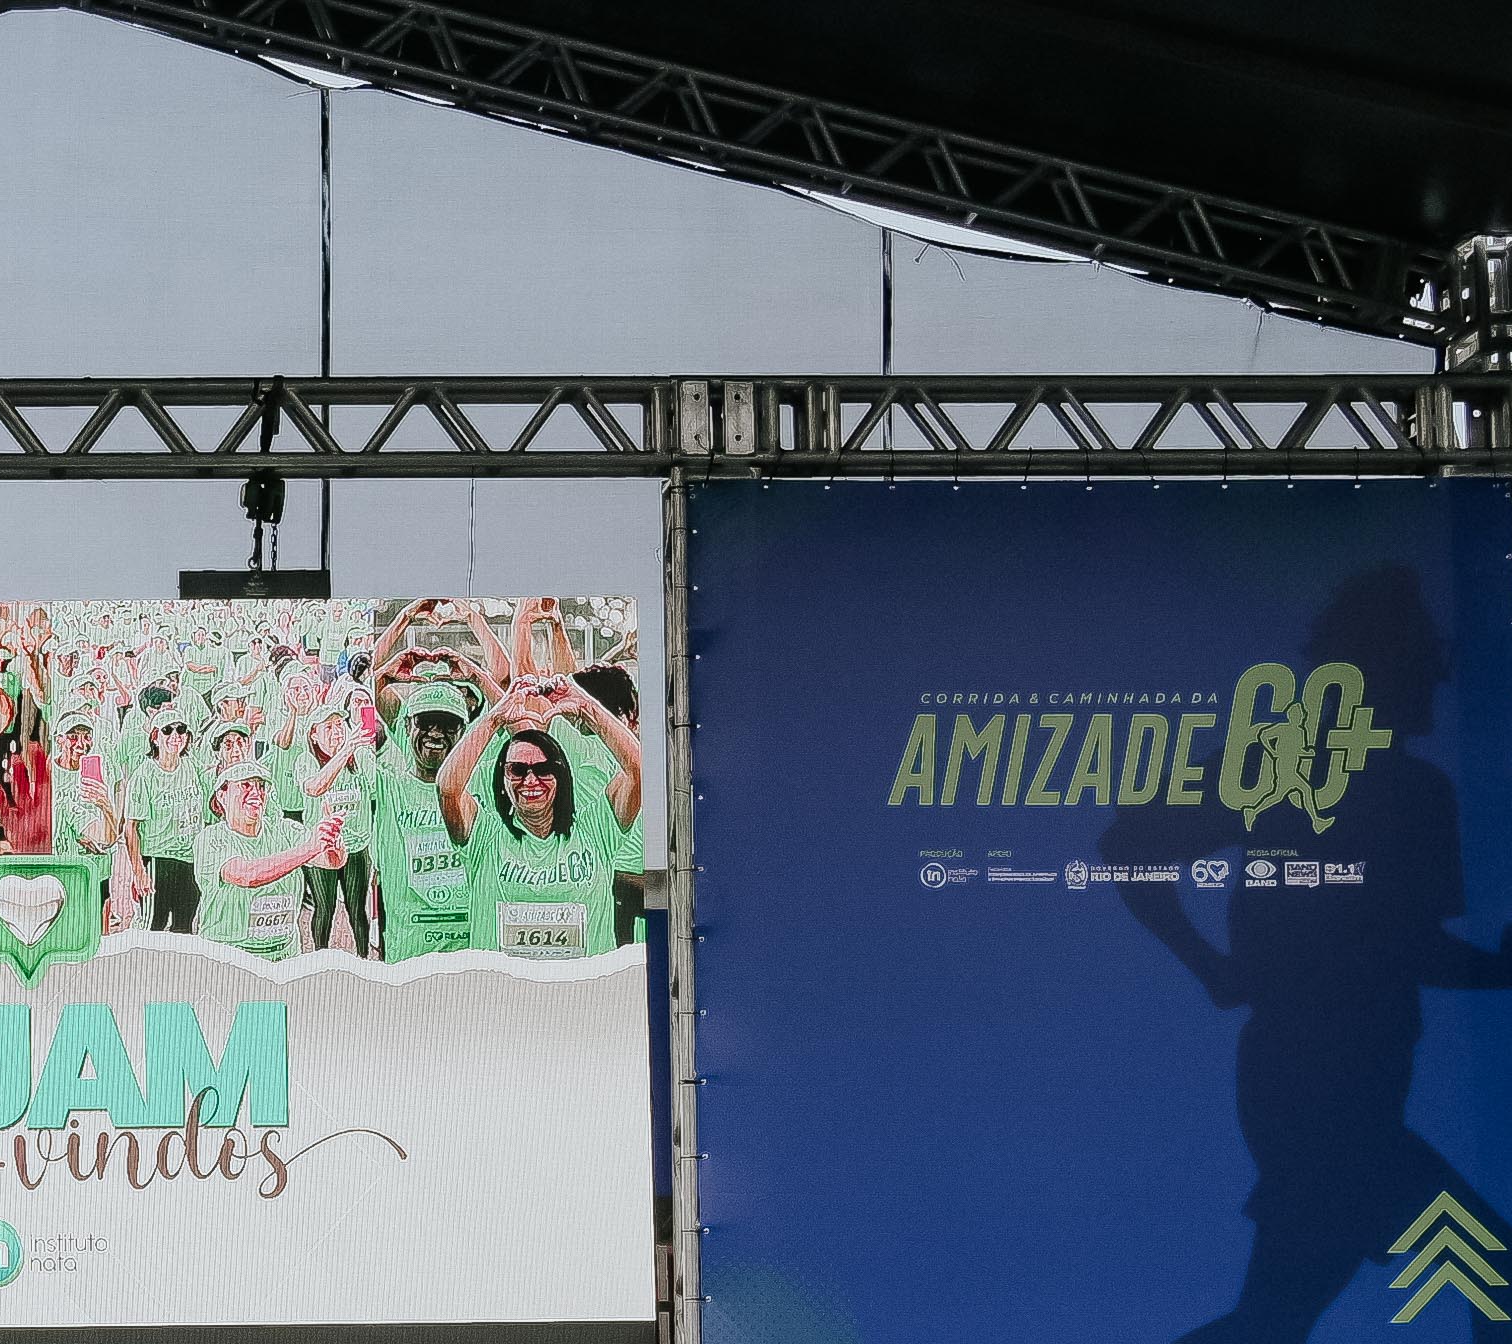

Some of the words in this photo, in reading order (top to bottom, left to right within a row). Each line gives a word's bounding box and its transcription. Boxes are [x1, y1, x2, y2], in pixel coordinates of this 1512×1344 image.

[921, 693, 1021, 705] CORRIDA
[1029, 693, 1039, 705] &
[1049, 693, 1181, 705] CAMINHADA
[1191, 692, 1219, 704] DA
[887, 713, 1217, 806] AMIZADE
[499, 857, 566, 885] AMIZADE
[516, 930, 568, 946] 1614
[28, 1233, 108, 1255] instituto
[28, 1253, 79, 1272] nata
